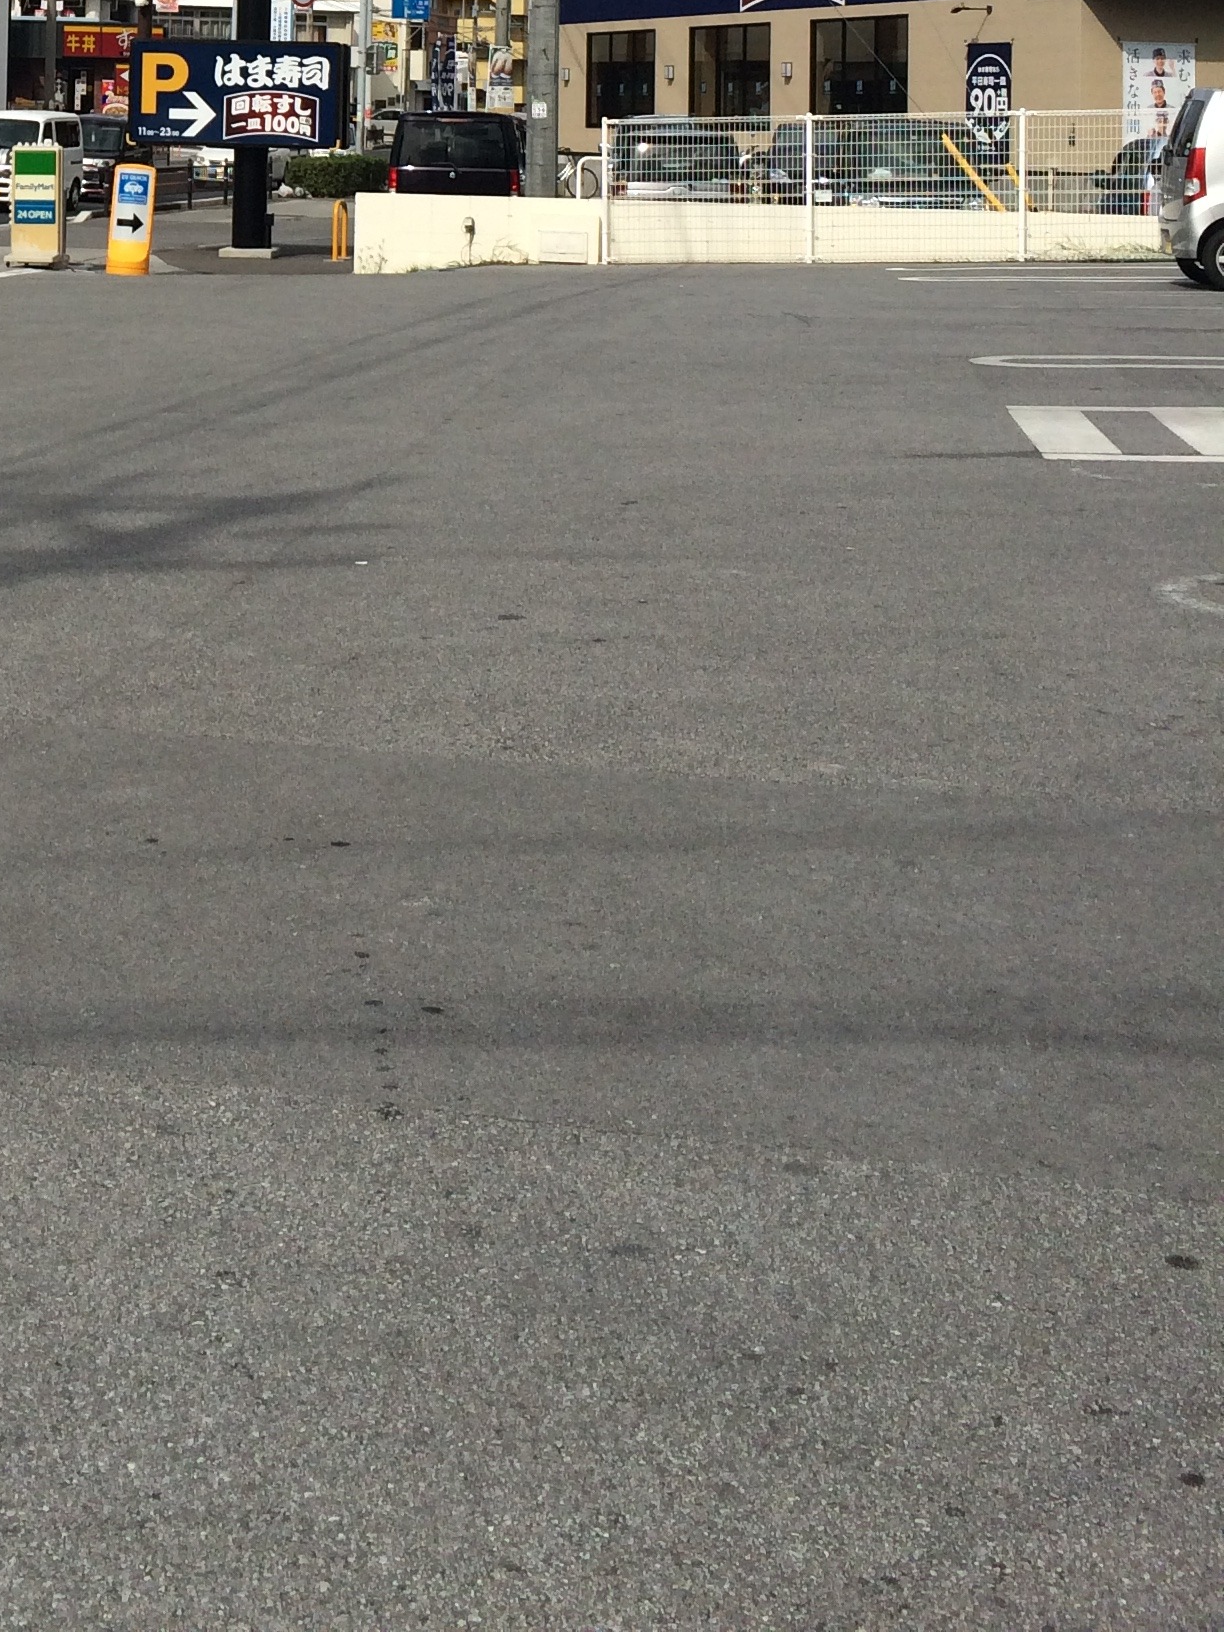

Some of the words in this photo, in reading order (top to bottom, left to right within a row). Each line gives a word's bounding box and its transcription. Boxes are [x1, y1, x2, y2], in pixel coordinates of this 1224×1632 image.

[66, 33, 96, 53] 牛丼
[214, 53, 331, 90] はま寿司
[141, 52, 190, 115] P
[231, 94, 312, 116] 回転すし
[16, 183, 54, 191] FamilyMart
[17, 210, 28, 220] 24
[28, 210, 53, 220] OPEN
